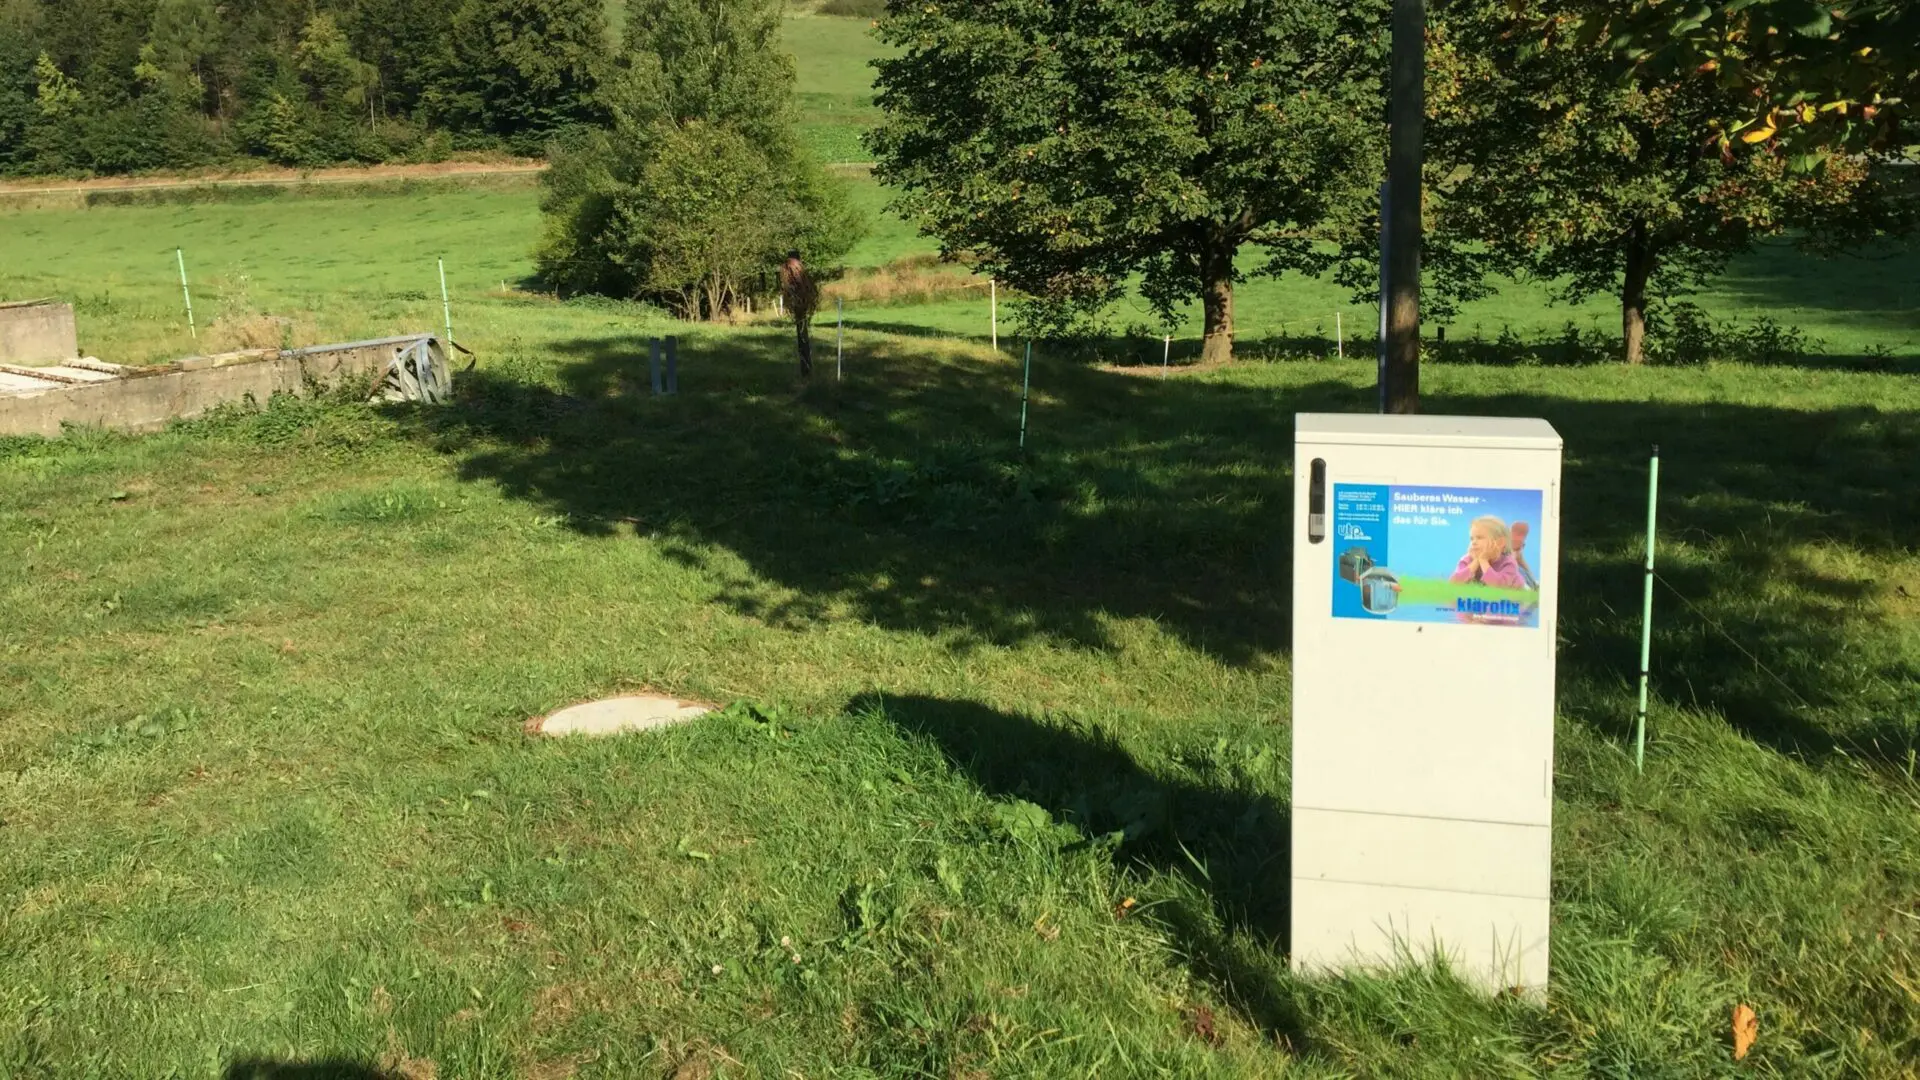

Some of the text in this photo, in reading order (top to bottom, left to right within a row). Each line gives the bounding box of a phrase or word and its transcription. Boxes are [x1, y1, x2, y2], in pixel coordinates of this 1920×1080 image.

[1393, 492, 1440, 502] Sauberes
[1442, 494, 1479, 504] Wasser
[1393, 503, 1418, 513] HIER
[1420, 505, 1446, 514] kläre
[1447, 506, 1463, 515] ich
[1413, 516, 1428, 525] für
[1457, 597, 1520, 615] klärofix
